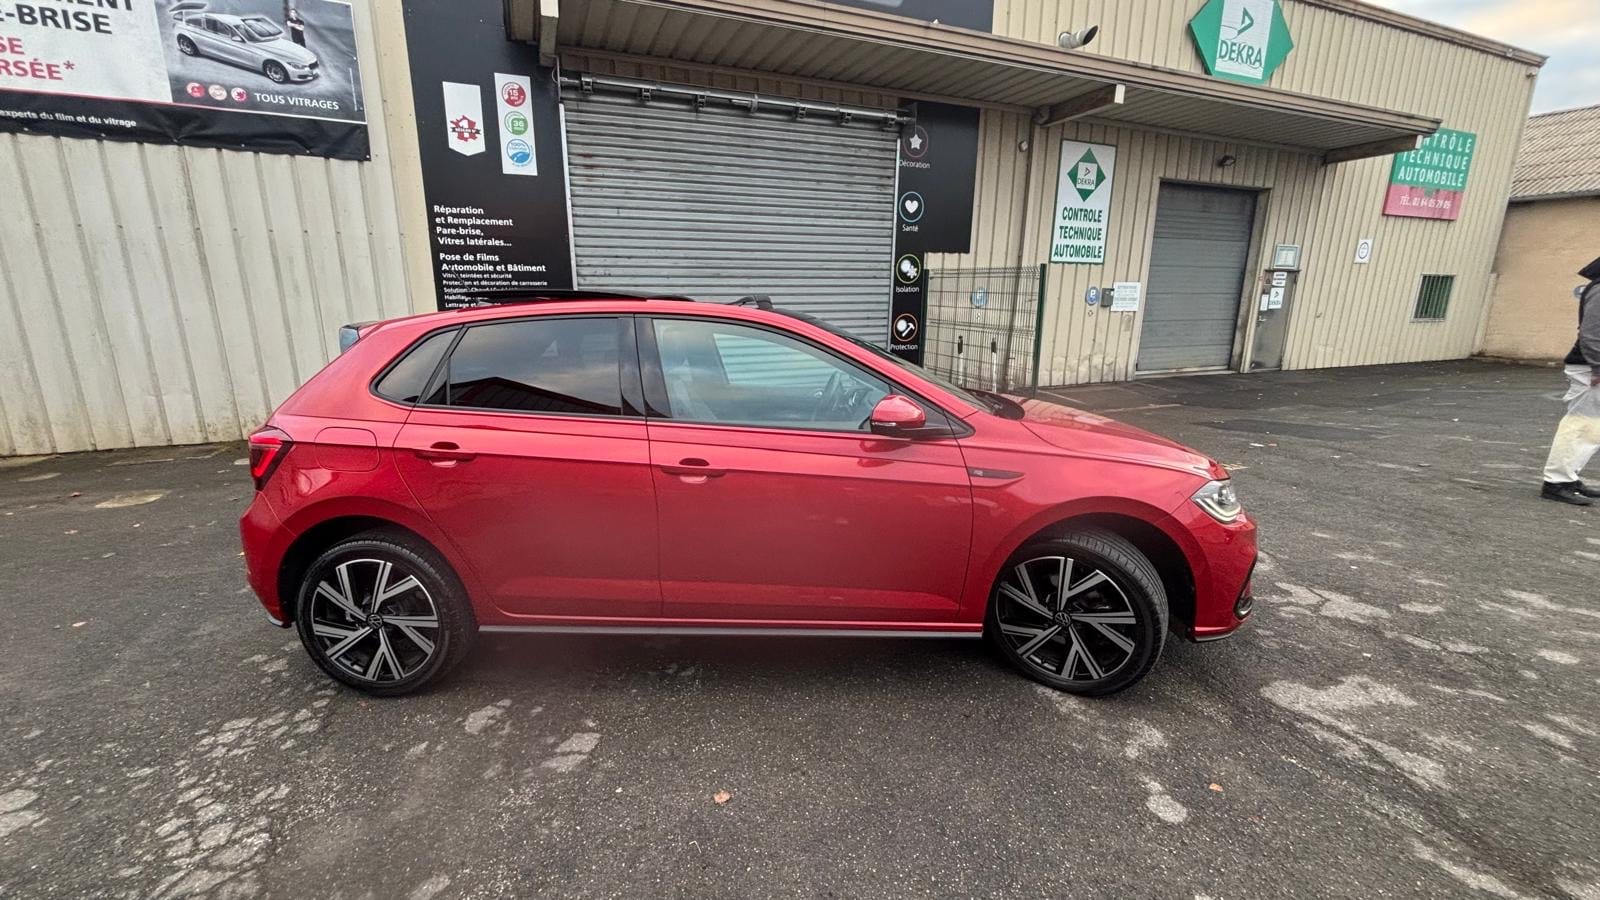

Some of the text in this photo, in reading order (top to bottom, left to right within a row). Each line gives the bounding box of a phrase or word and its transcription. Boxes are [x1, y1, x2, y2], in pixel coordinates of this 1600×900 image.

[1219, 39, 1262, 67] DEKRA
[254, 92, 339, 110] TOUS VITRAGES
[0, 109, 137, 128] experts du film et du vitrage
[899, 159, 931, 169] Décoration
[1402, 149, 1469, 170] TECHNIQUE
[1398, 166, 1464, 186] AUTOMOBILE
[1077, 178, 1095, 186] DEKRA
[433, 205, 484, 215] Réparation
[1062, 206, 1103, 223] CONTROLE
[435, 216, 514, 226] et Remplacement
[436, 226, 484, 236] Pare-brise,
[902, 223, 919, 232] Santé
[1059, 226, 1103, 241] TECHNIQUE
[437, 237, 512, 246] Vitres latérales...
[440, 252, 500, 261] Pose de Films
[1053, 244, 1103, 259] AUTOMOBILE
[507, 263, 546, 272] Bâtiment
[890, 343, 919, 351] Protection
